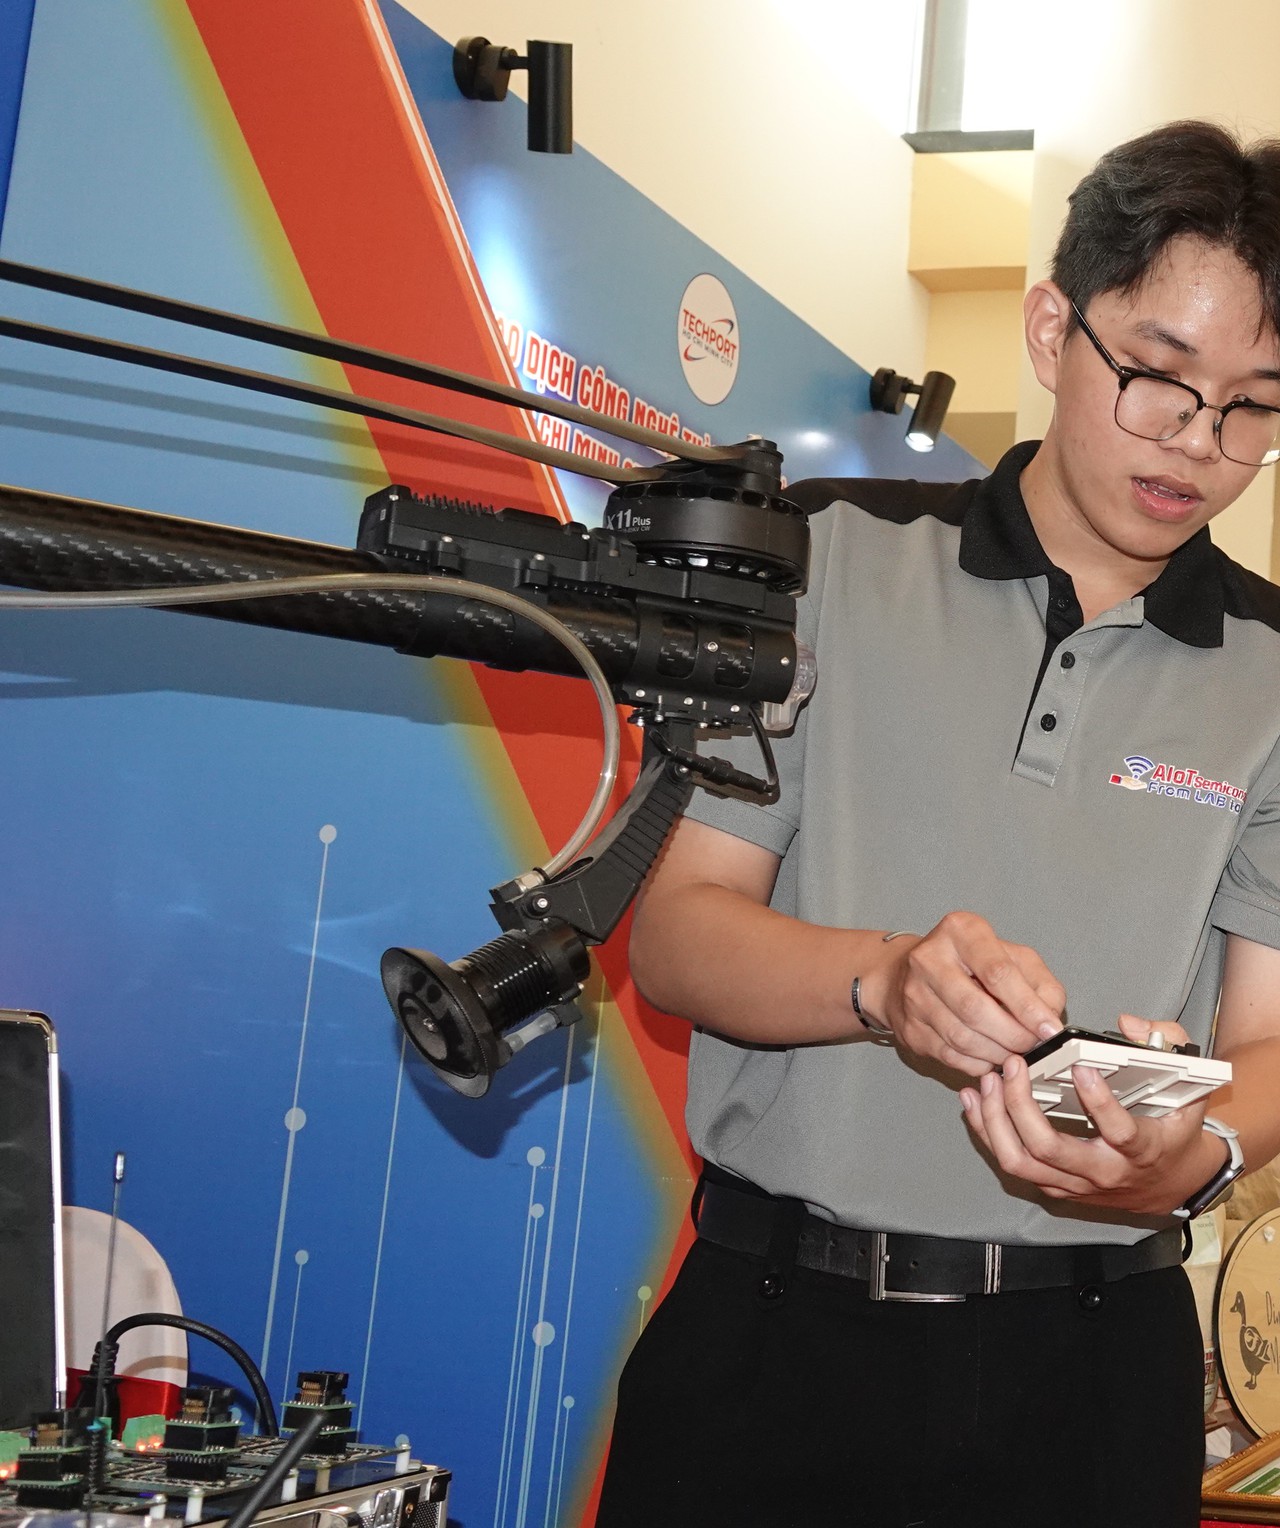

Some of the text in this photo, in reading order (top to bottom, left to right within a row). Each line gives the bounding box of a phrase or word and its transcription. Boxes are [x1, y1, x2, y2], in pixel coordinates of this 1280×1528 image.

[683, 309, 737, 361] TECHPORT
[525, 334, 575, 399] DỊCH
[579, 367, 629, 422] CÔNG
[606, 509, 652, 531] X11 Plus
[1148, 782, 1190, 799] From
[1195, 789, 1226, 807] LAB
